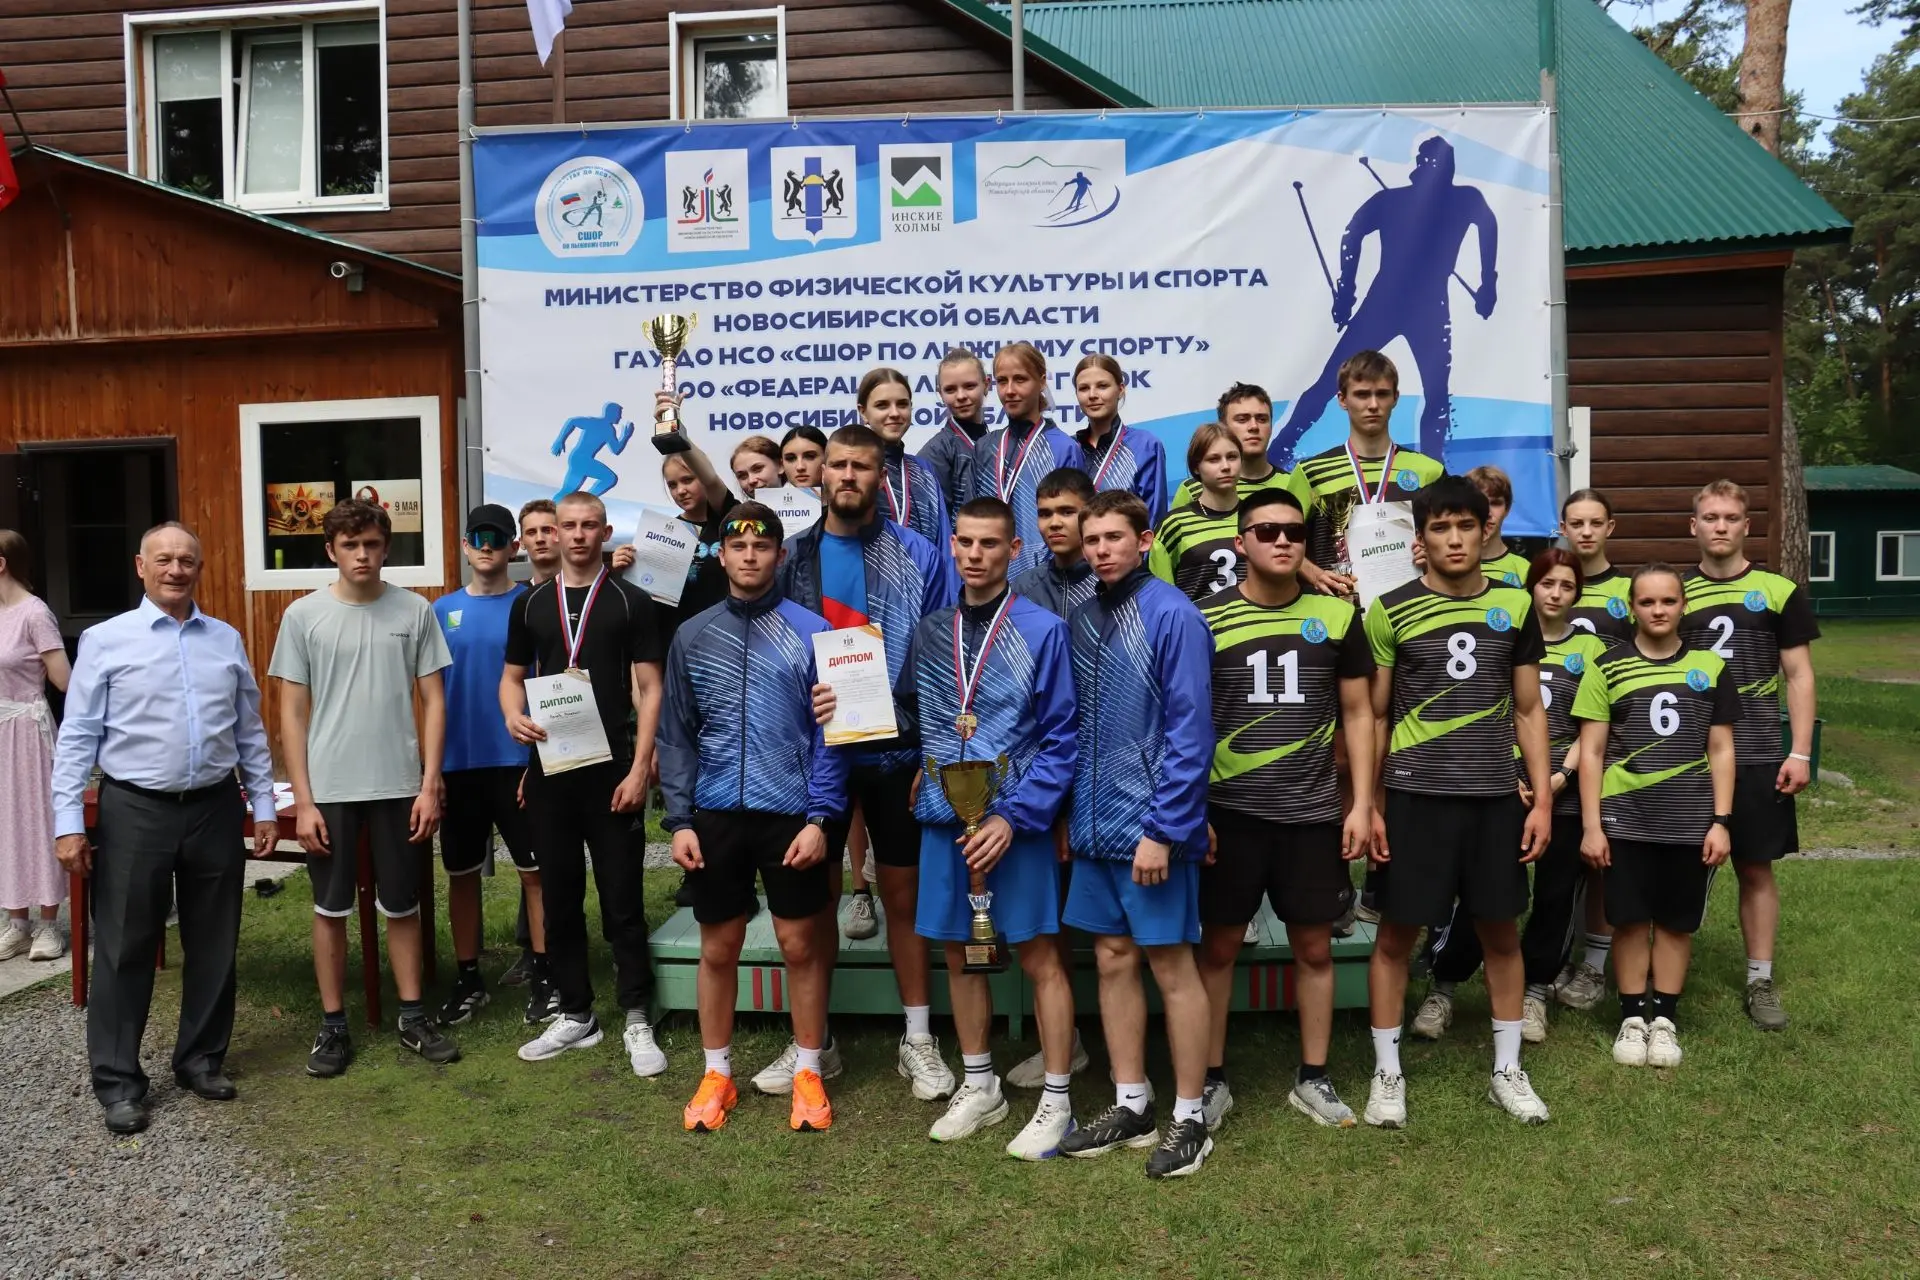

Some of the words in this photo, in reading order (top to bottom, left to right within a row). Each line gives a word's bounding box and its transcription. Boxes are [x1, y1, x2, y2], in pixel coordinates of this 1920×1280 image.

[891, 211, 943, 222] ИНСКИЕ
[577, 230, 603, 241] СШОР
[894, 222, 941, 233] ХОЛМЫ
[545, 280, 763, 307] МИНИСТЕРСТВО
[768, 270, 962, 297] ФИЗИЧЕСКОЙ
[968, 271, 1124, 293] КУЛЬТУРЫ
[1129, 271, 1149, 290] И
[1154, 268, 1269, 289] СПОРТА
[713, 302, 959, 332] НОВОСИБИРСКОЙ
[964, 305, 1099, 326] ОБЛАСТИ
[675, 348, 714, 369] ДО
[718, 345, 775, 366] НСО
[780, 342, 873, 363] «СШОР
[878, 342, 917, 361] ПО
[1079, 335, 1210, 356] СПОРТУ»
[394, 501, 400, 511] 9
[402, 501, 418, 511] МАЯ
[774, 509, 810, 517] ИПЛОМ
[645, 531, 686, 549] ДИПЛОМ
[1361, 541, 1406, 558] ДИПЛОМ
[1208, 548, 1238, 593] 3
[1708, 615, 1735, 659] 2
[829, 651, 873, 668] ДИПЛОМ
[1446, 631, 1478, 681] 8
[1246, 649, 1306, 704] 11
[540, 694, 582, 709] ДИПЛОМ
[1649, 691, 1681, 737] 6
